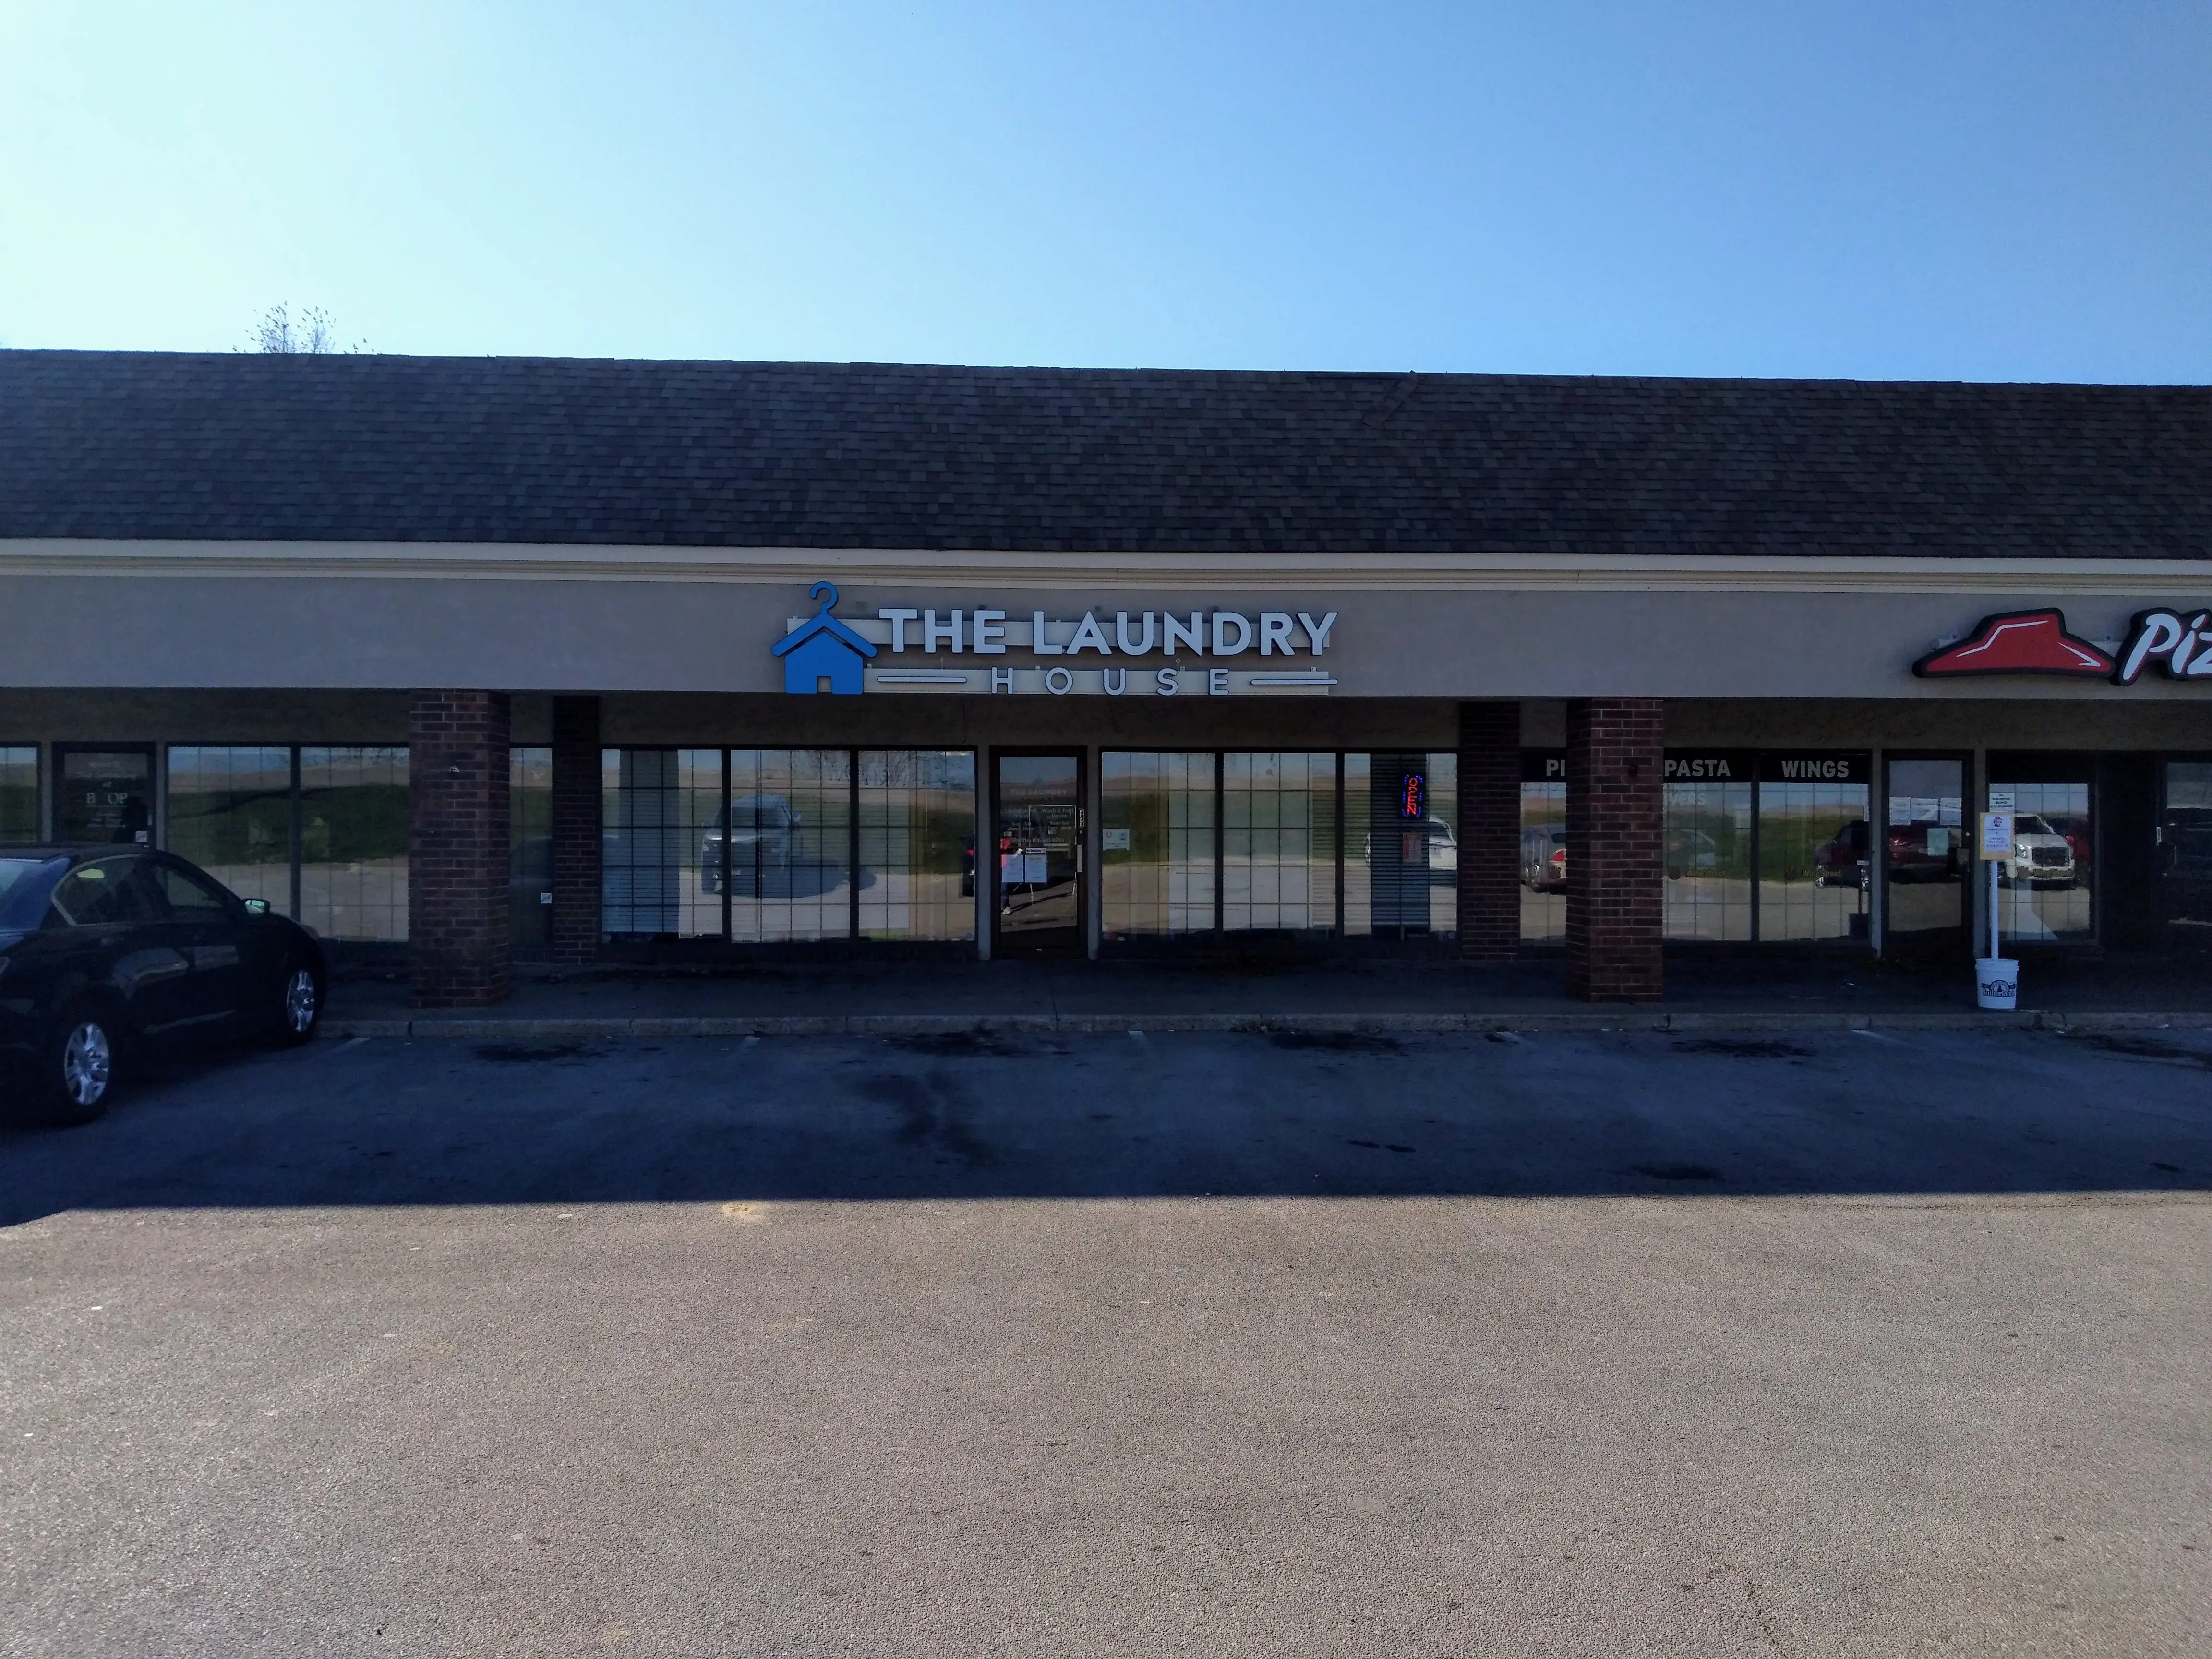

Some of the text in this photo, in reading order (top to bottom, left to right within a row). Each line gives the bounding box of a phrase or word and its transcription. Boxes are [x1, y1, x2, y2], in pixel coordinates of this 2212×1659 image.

[878, 608, 1338, 657] THE LAUNDRY
[991, 667, 1230, 697] HOUSE
[1664, 760, 1731, 777] PASTA
[1781, 760, 1849, 778] WINGS
[1407, 777, 1418, 815] OPEN
